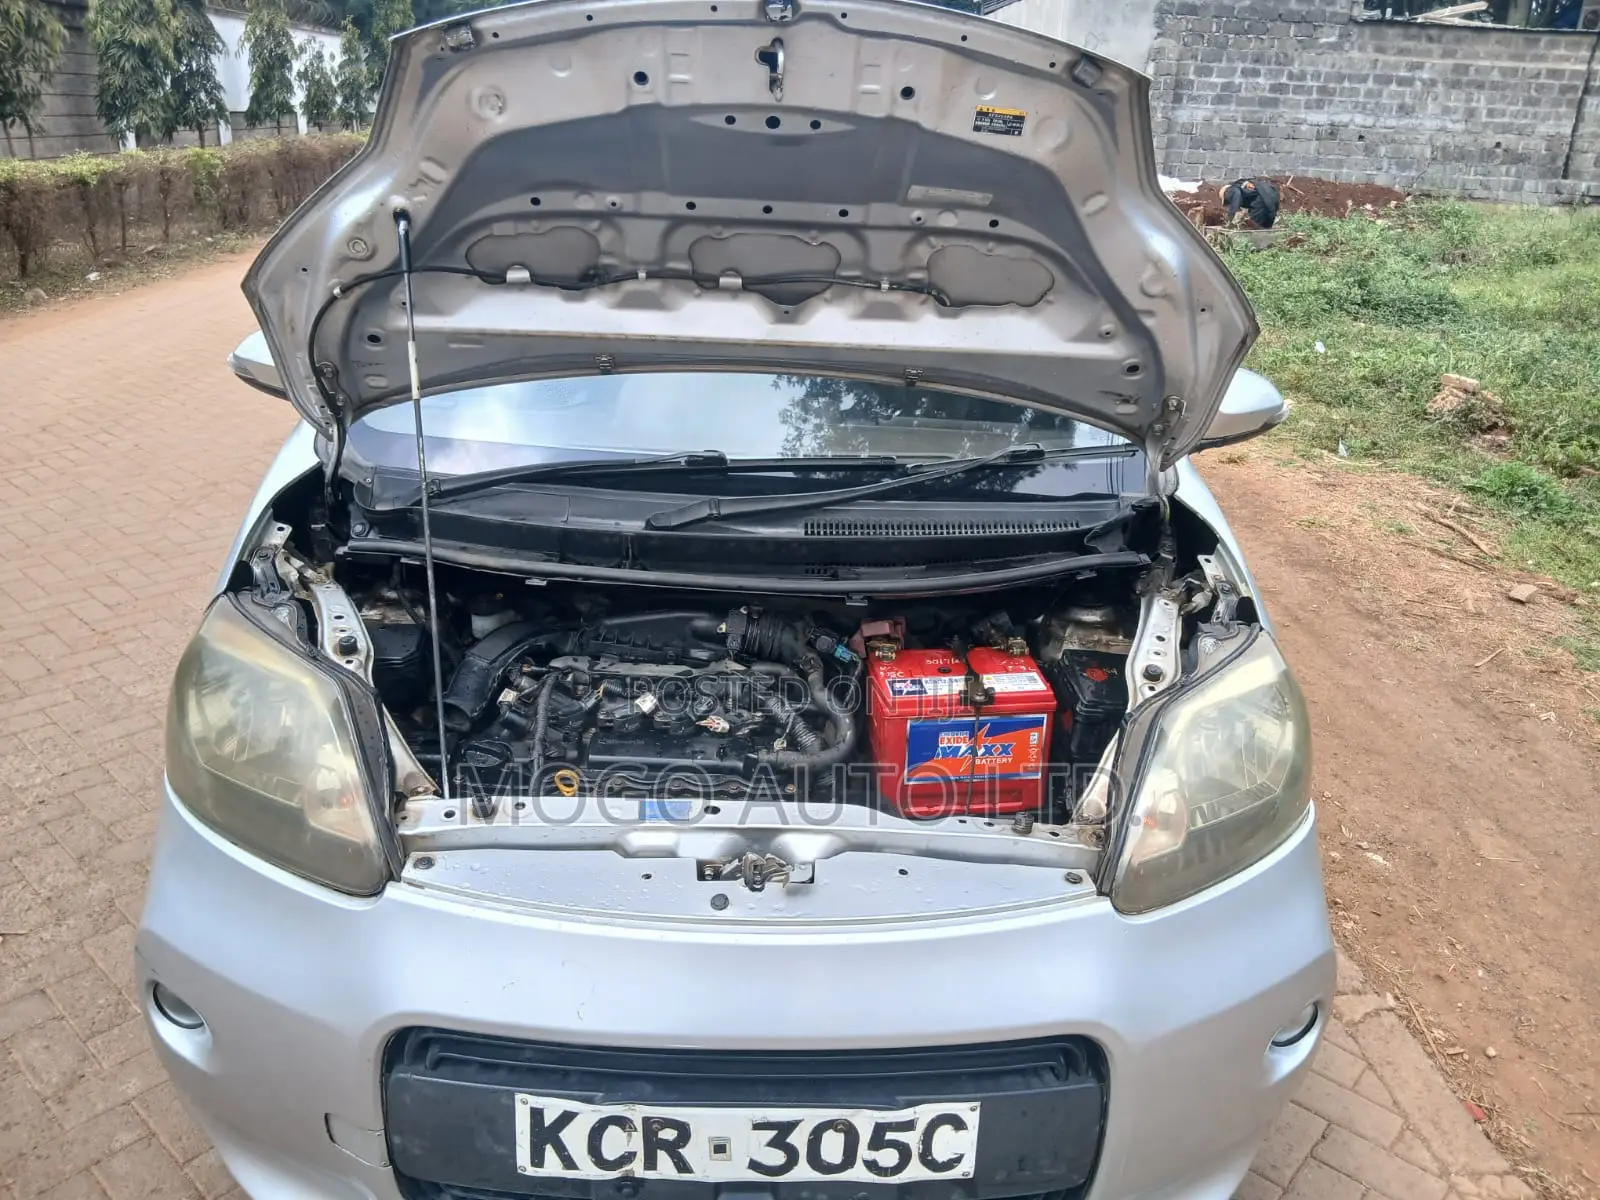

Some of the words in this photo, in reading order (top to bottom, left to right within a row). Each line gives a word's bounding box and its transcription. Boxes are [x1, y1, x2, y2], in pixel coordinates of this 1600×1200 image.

[939, 736, 969, 745] EXIDE
[934, 743, 1015, 759] MAXX
[975, 757, 1013, 765] BATTERY
[529, 1107, 695, 1174] KCR
[747, 1112, 968, 1178] 305C
